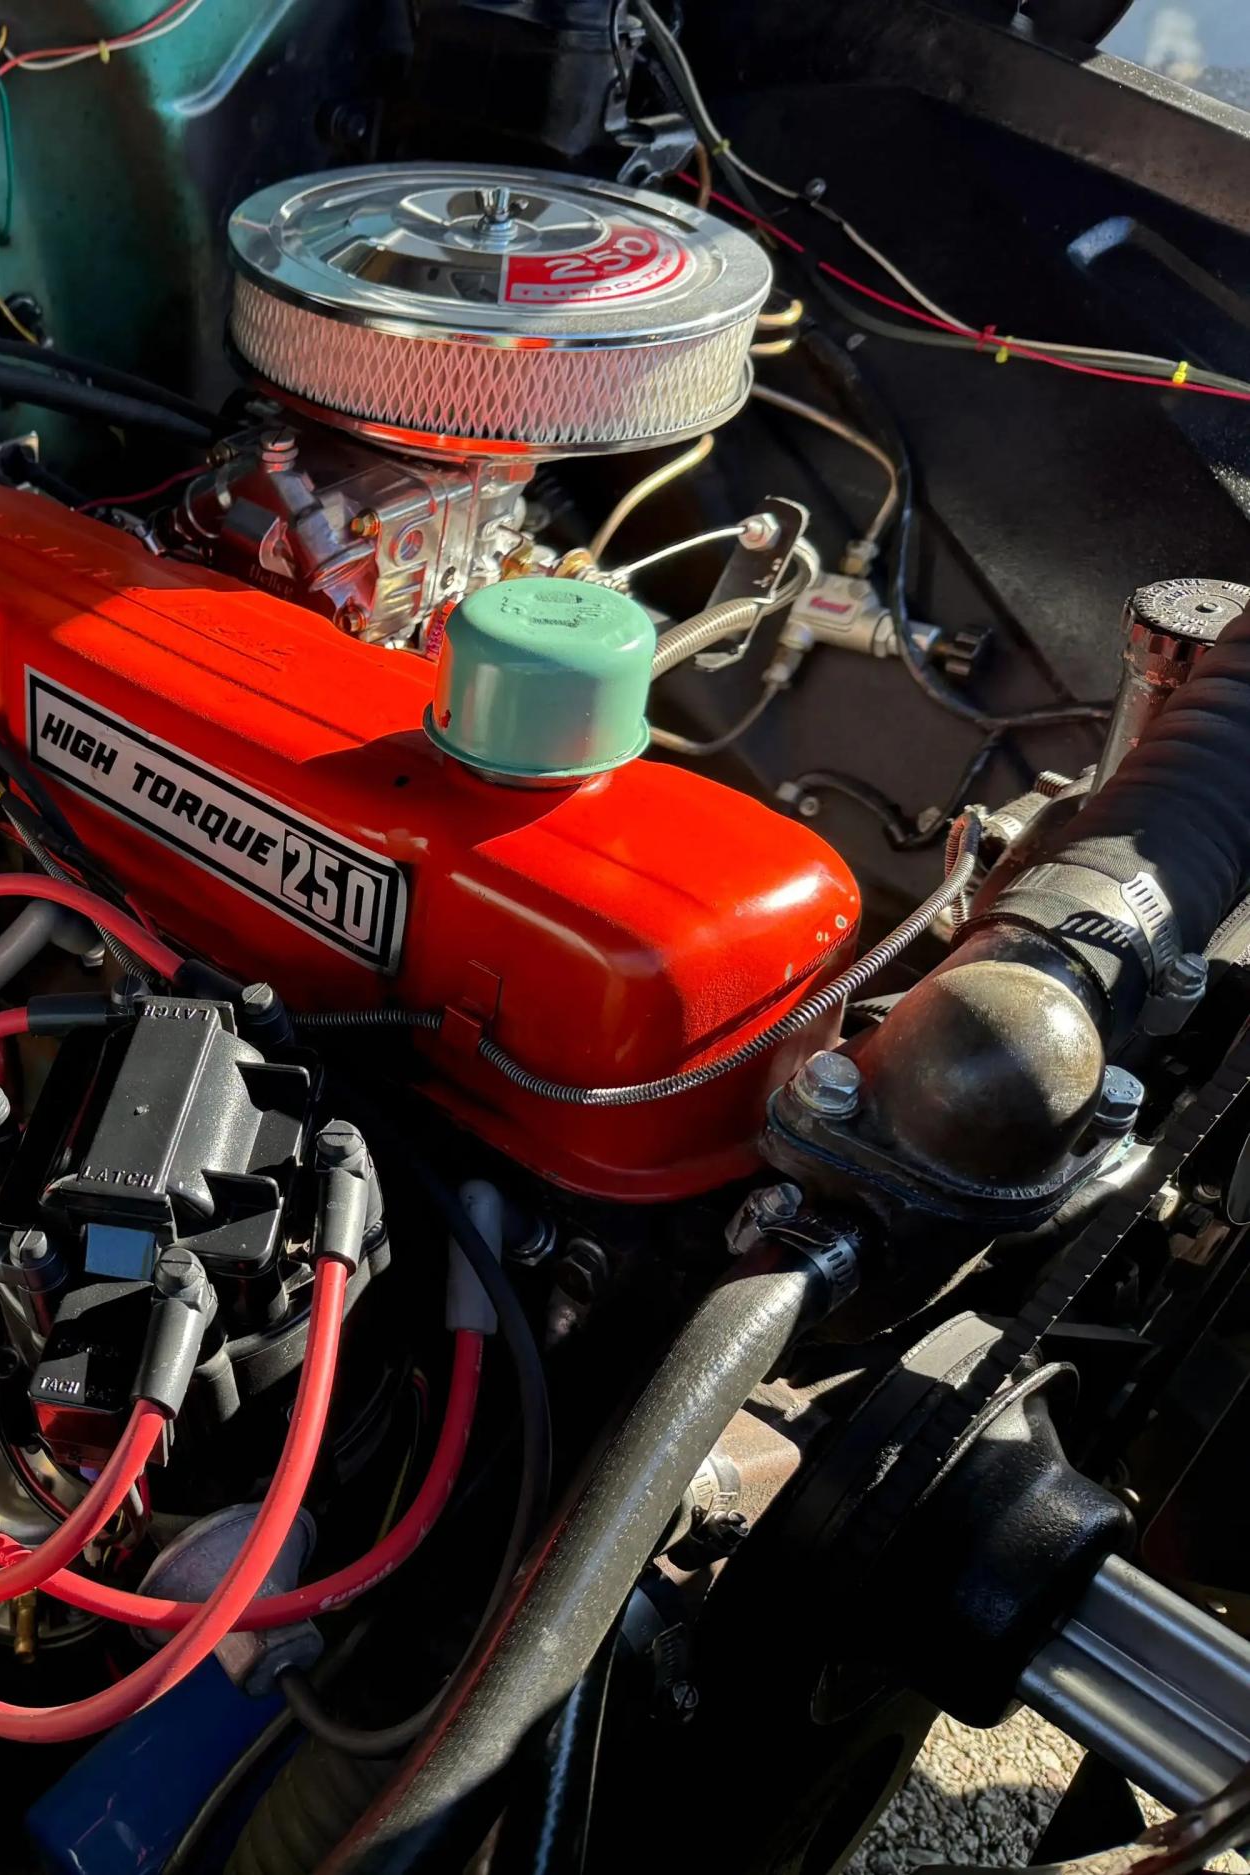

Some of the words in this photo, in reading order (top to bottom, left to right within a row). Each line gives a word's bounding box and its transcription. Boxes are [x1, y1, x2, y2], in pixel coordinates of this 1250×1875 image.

[544, 236, 650, 281] 250
[39, 712, 118, 775] HIGH
[131, 761, 278, 867] TORQUE
[282, 834, 376, 941] 250
[144, 1004, 211, 1021] LATCH
[82, 1165, 155, 1188] LATCH
[40, 1376, 81, 1395] TACH
